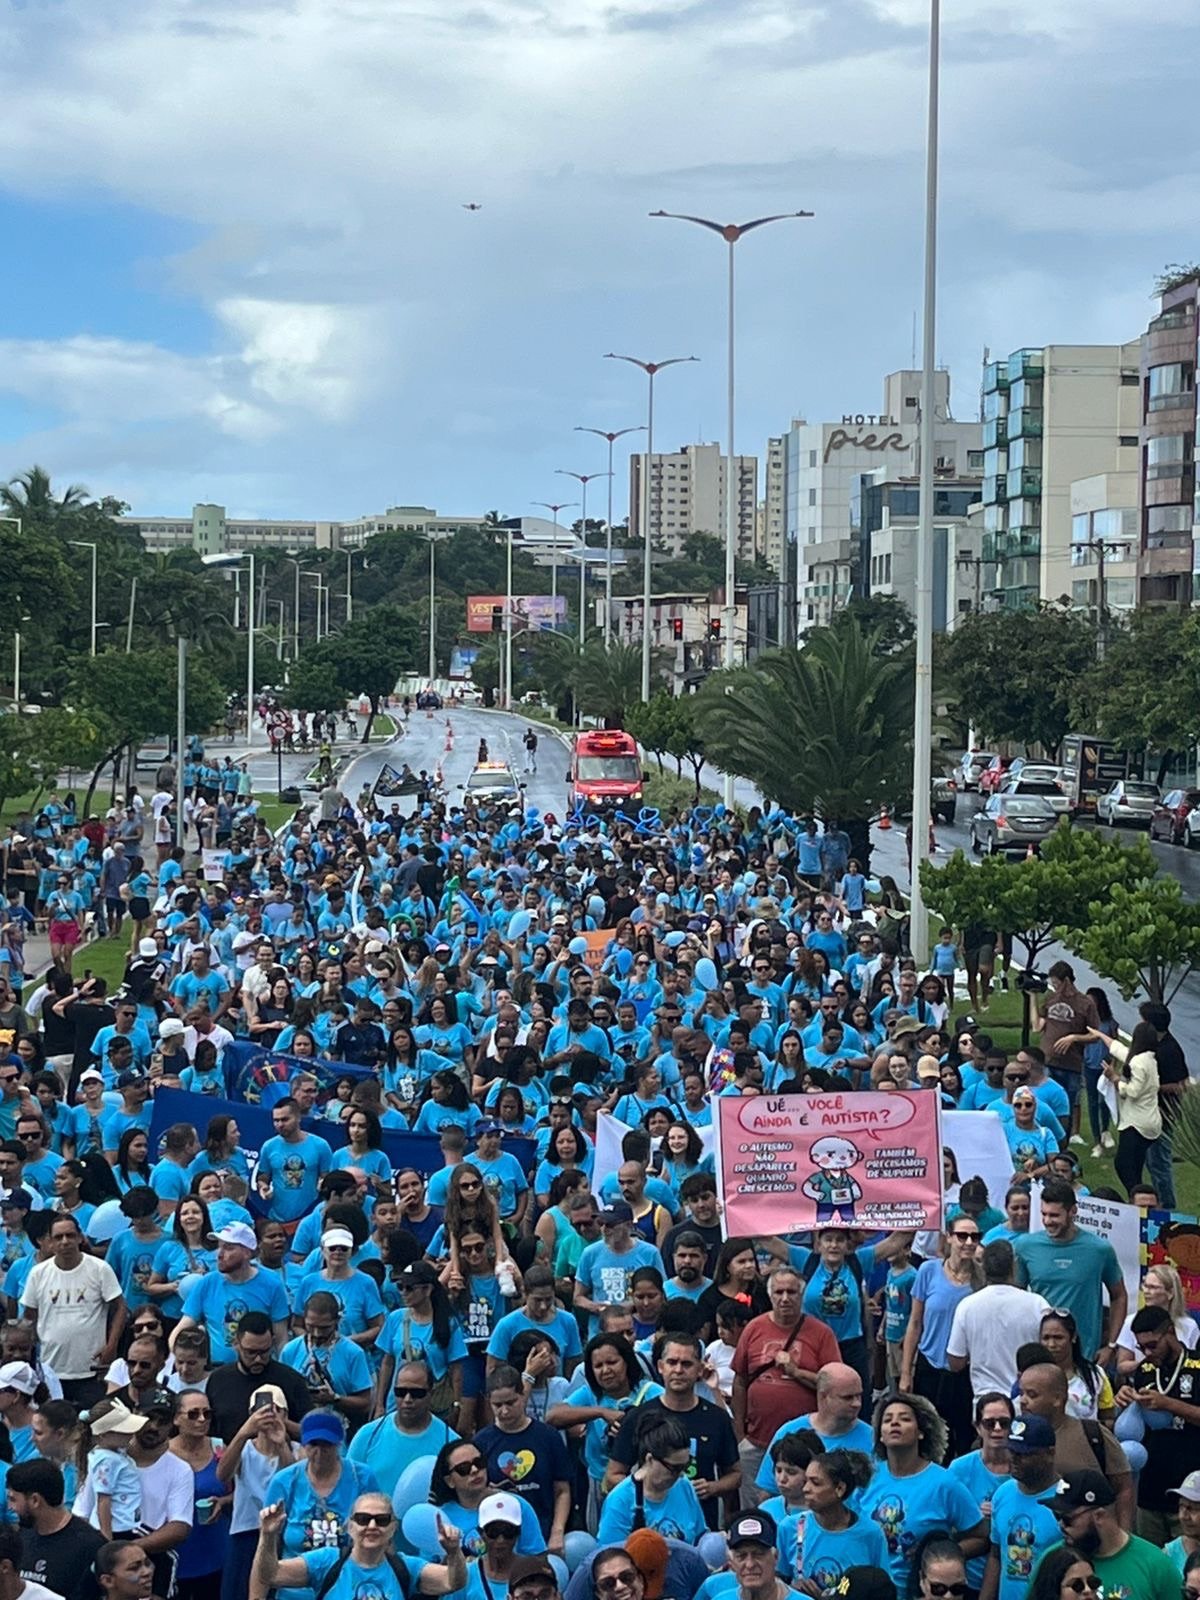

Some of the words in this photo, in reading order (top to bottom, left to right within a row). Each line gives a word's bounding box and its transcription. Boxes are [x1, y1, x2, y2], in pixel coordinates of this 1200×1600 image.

[842, 414, 898, 426] HOTEL
[807, 1095, 843, 1110] VOCÊ
[753, 1116, 792, 1128] AINDA
[800, 1114, 809, 1126] É
[821, 1109, 890, 1125] AUTISTA?
[739, 1143, 748, 1153] O
[750, 1141, 793, 1152] AUTISMO
[876, 1148, 915, 1157] TAMBÉM
[755, 1152, 775, 1161] NÃO
[735, 1162, 795, 1172] DESAPARECE
[866, 1158, 927, 1168] PRECISAMOS
[746, 1173, 787, 1183] QUANDO
[867, 1169, 880, 1178] DE
[882, 1168, 925, 1178] SUPORTE
[738, 1183, 795, 1193] CRESCEMOS
[881, 1203, 892, 1211] DE
[601, 1267, 624, 1280] RES
[606, 1289, 625, 1301] TO
[469, 1303, 488, 1315] EM
[469, 1314, 487, 1325] PA
[468, 1324, 489, 1336] TIA
